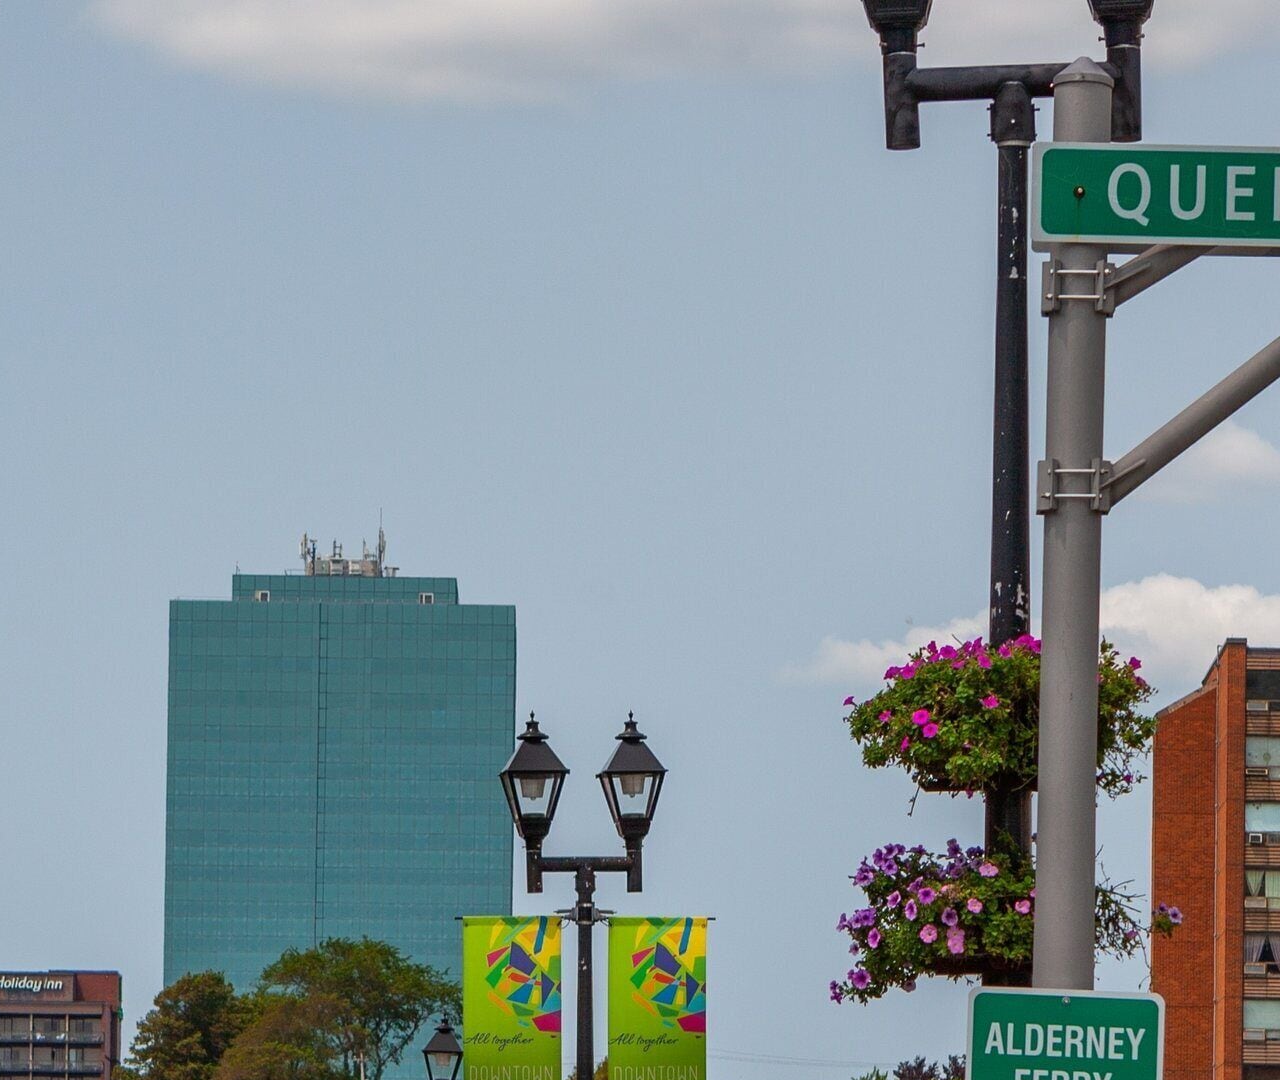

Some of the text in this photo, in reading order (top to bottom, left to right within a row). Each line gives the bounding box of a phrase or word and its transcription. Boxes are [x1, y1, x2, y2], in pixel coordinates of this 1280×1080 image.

[43, 976, 63, 990] Inn
[464, 1032, 534, 1051] All together
[608, 1032, 679, 1051] All together
[984, 1021, 1146, 1061] ALDERNEY
